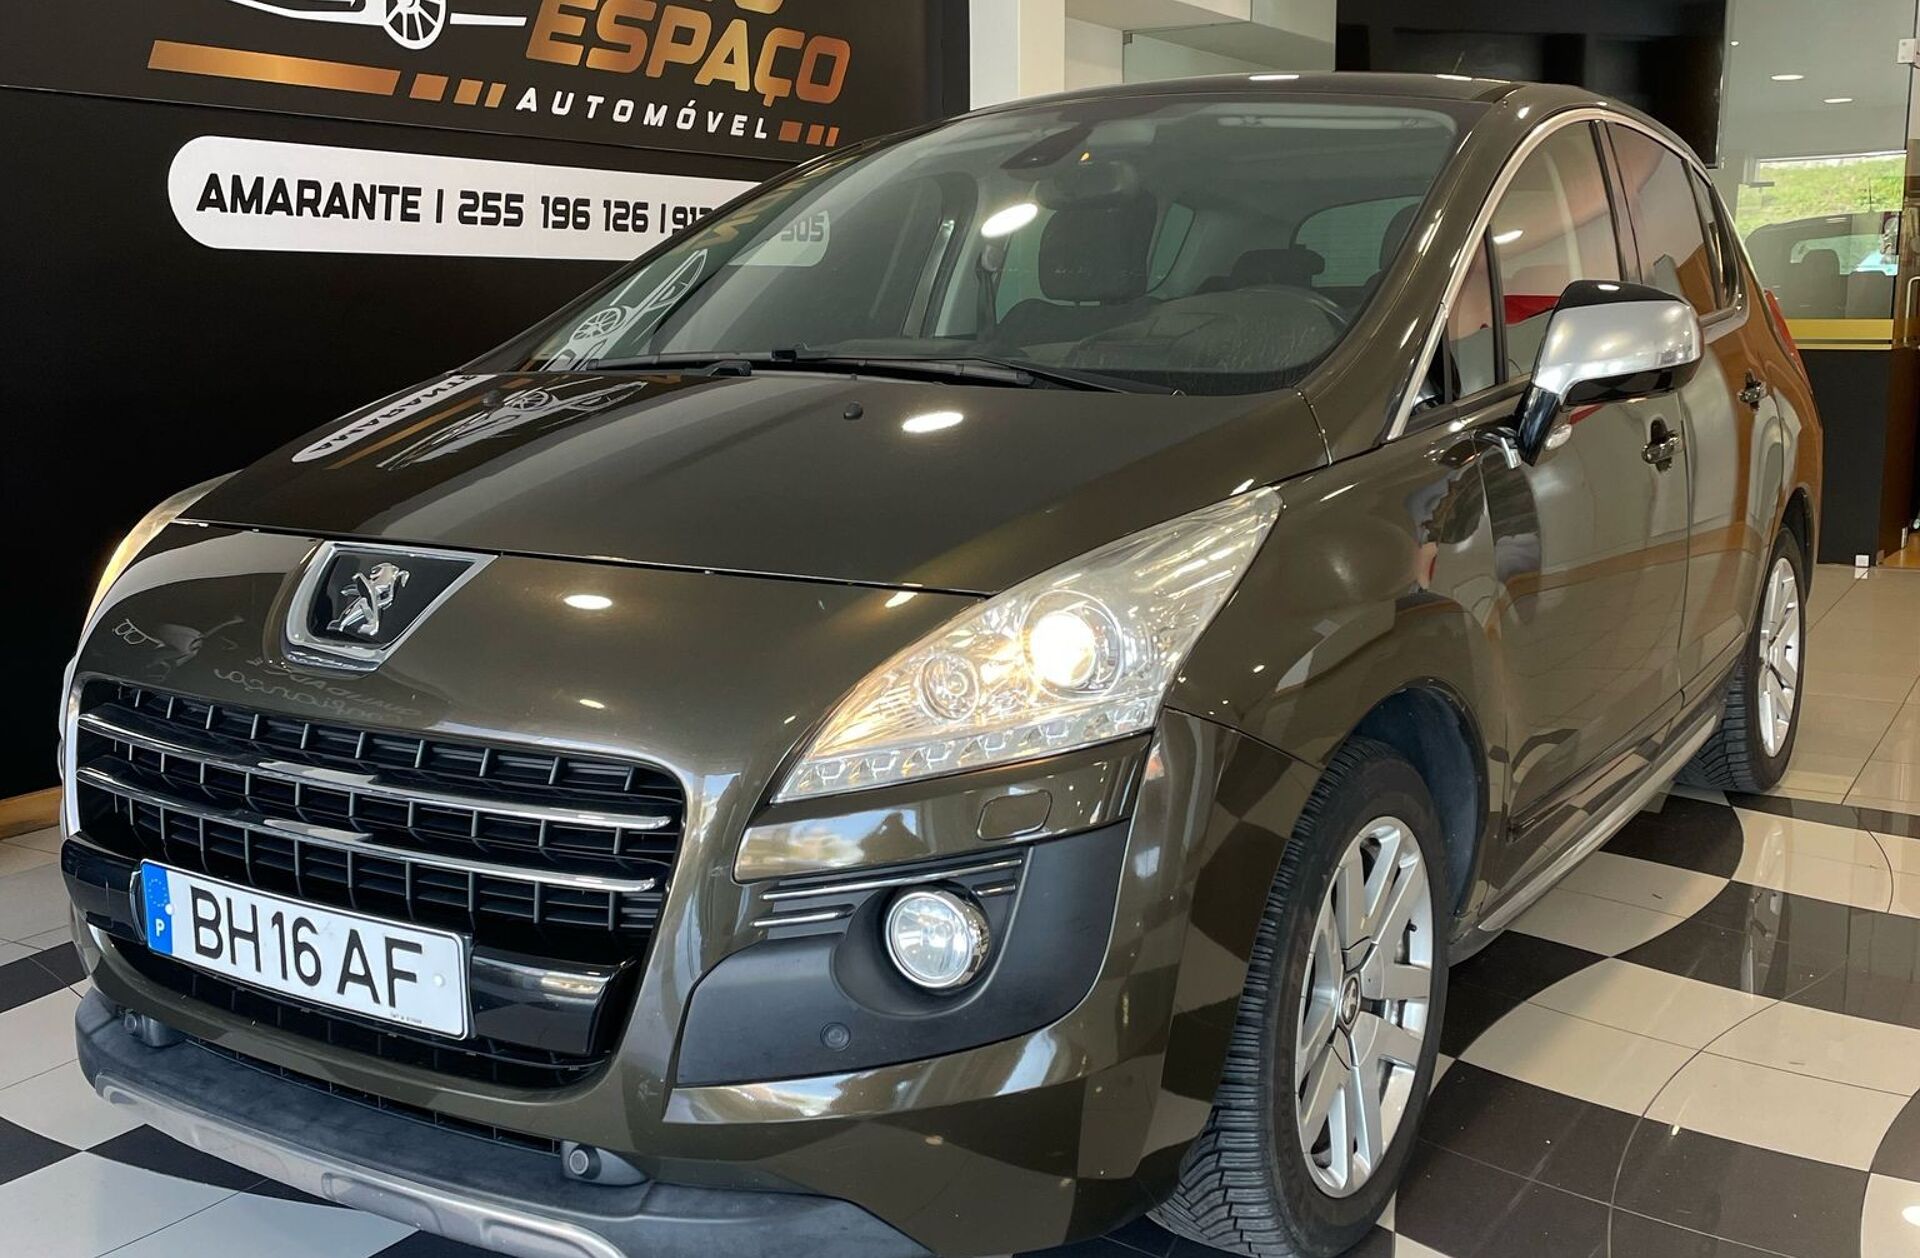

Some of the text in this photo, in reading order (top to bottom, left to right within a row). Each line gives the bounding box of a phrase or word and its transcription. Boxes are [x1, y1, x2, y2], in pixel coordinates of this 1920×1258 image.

[526, 0, 851, 108] ESPAÇO
[515, 87, 768, 140] AUTOMÓVEL
[196, 172, 422, 223] AMARANTE
[458, 190, 525, 227] 255
[540, 195, 591, 231] 196
[603, 199, 649, 233] 126
[154, 917, 166, 938] P
[336, 928, 423, 1008] AF
